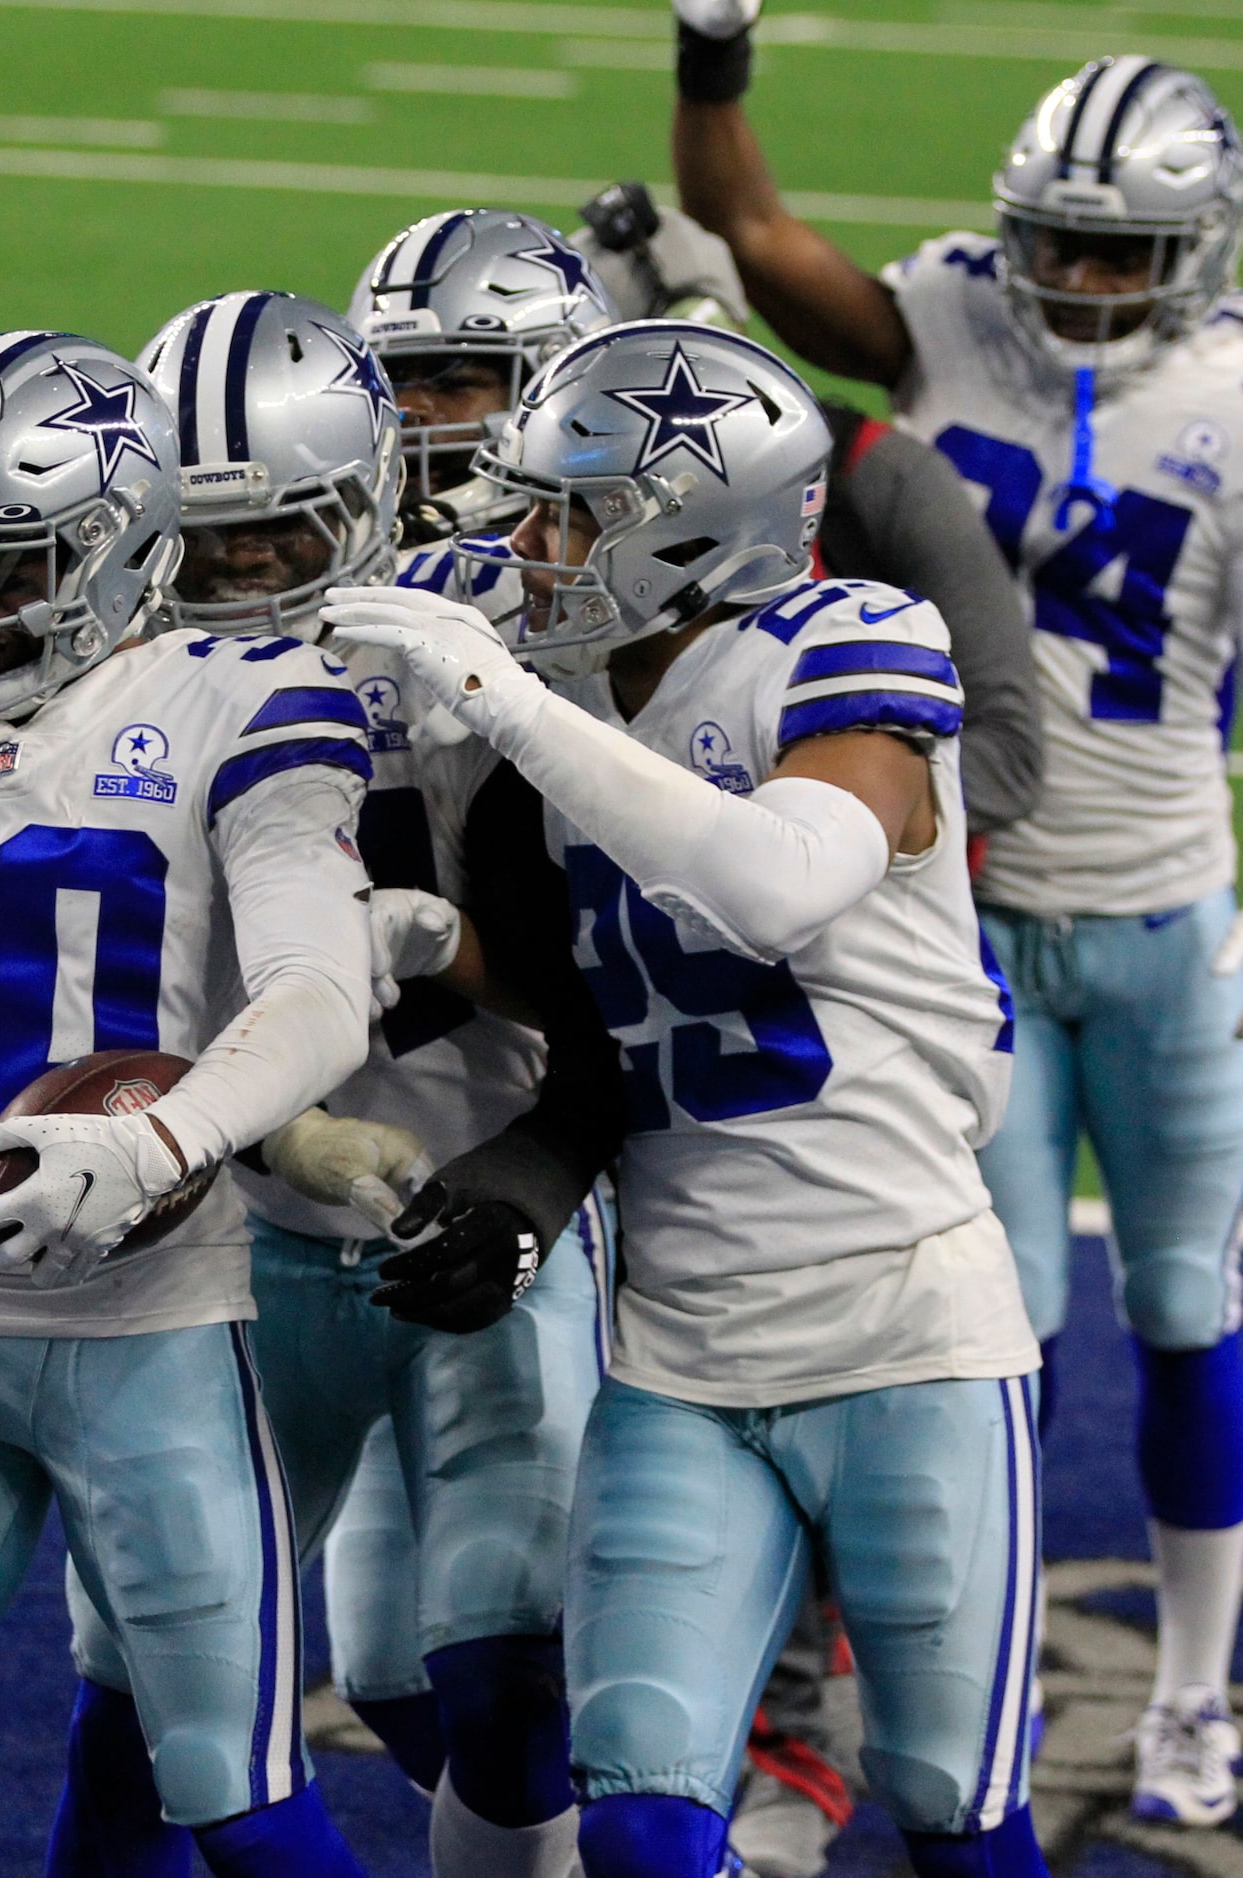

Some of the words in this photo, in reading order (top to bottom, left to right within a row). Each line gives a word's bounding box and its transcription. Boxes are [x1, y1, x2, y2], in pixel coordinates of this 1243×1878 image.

[189, 468, 247, 486] COWBOYS
[95, 777, 131, 795] EST.
[135, 780, 175, 801] 1960
[110, 1084, 159, 1115] NFL
